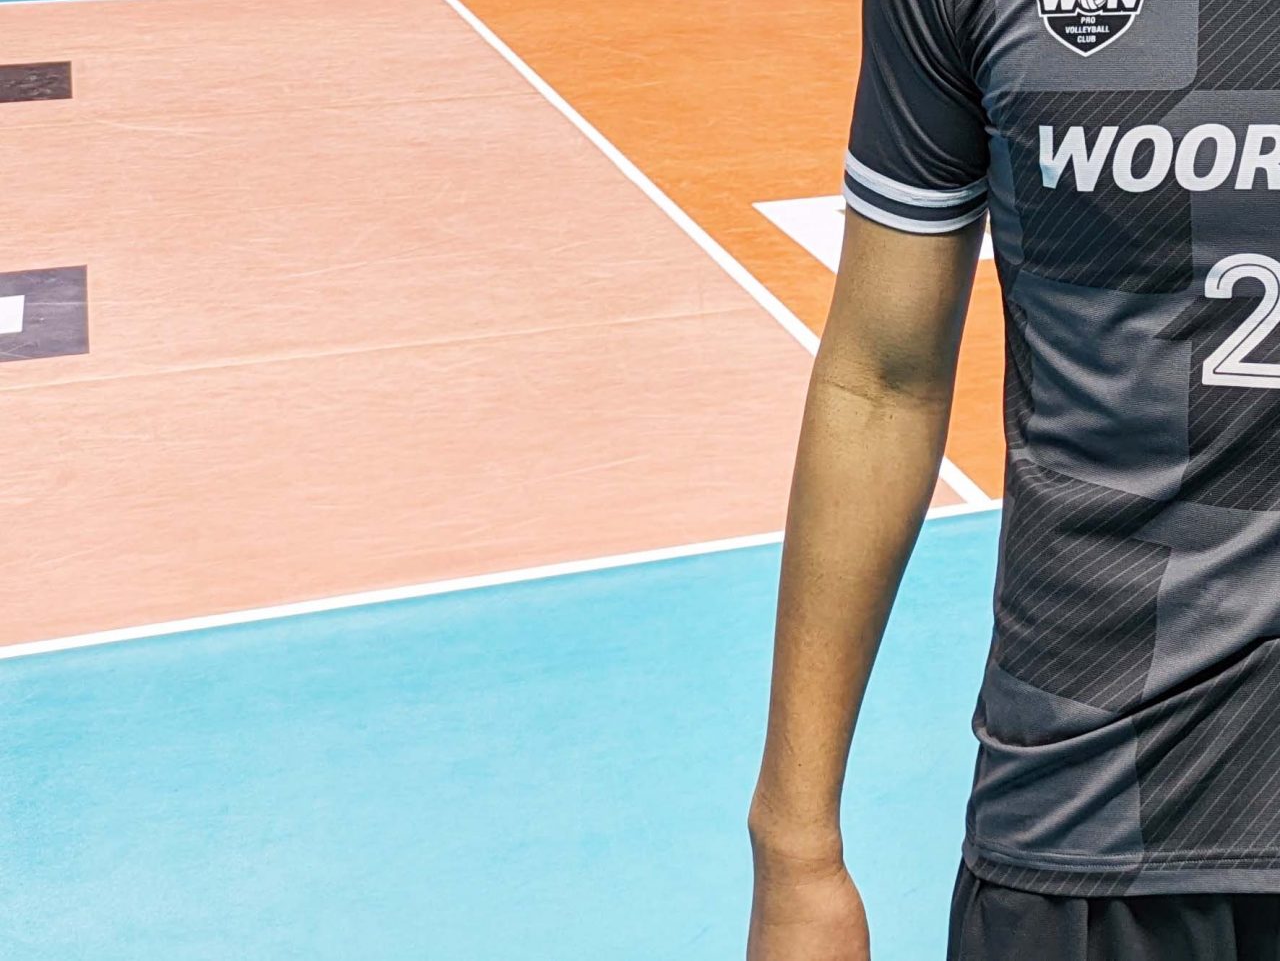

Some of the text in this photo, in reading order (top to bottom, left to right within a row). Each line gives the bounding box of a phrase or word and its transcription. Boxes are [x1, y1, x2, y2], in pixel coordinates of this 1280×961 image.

[1080, 16, 1096, 24] PRO
[1065, 25, 1110, 34] VOLLEYBALL
[1077, 35, 1096, 43] CLUB
